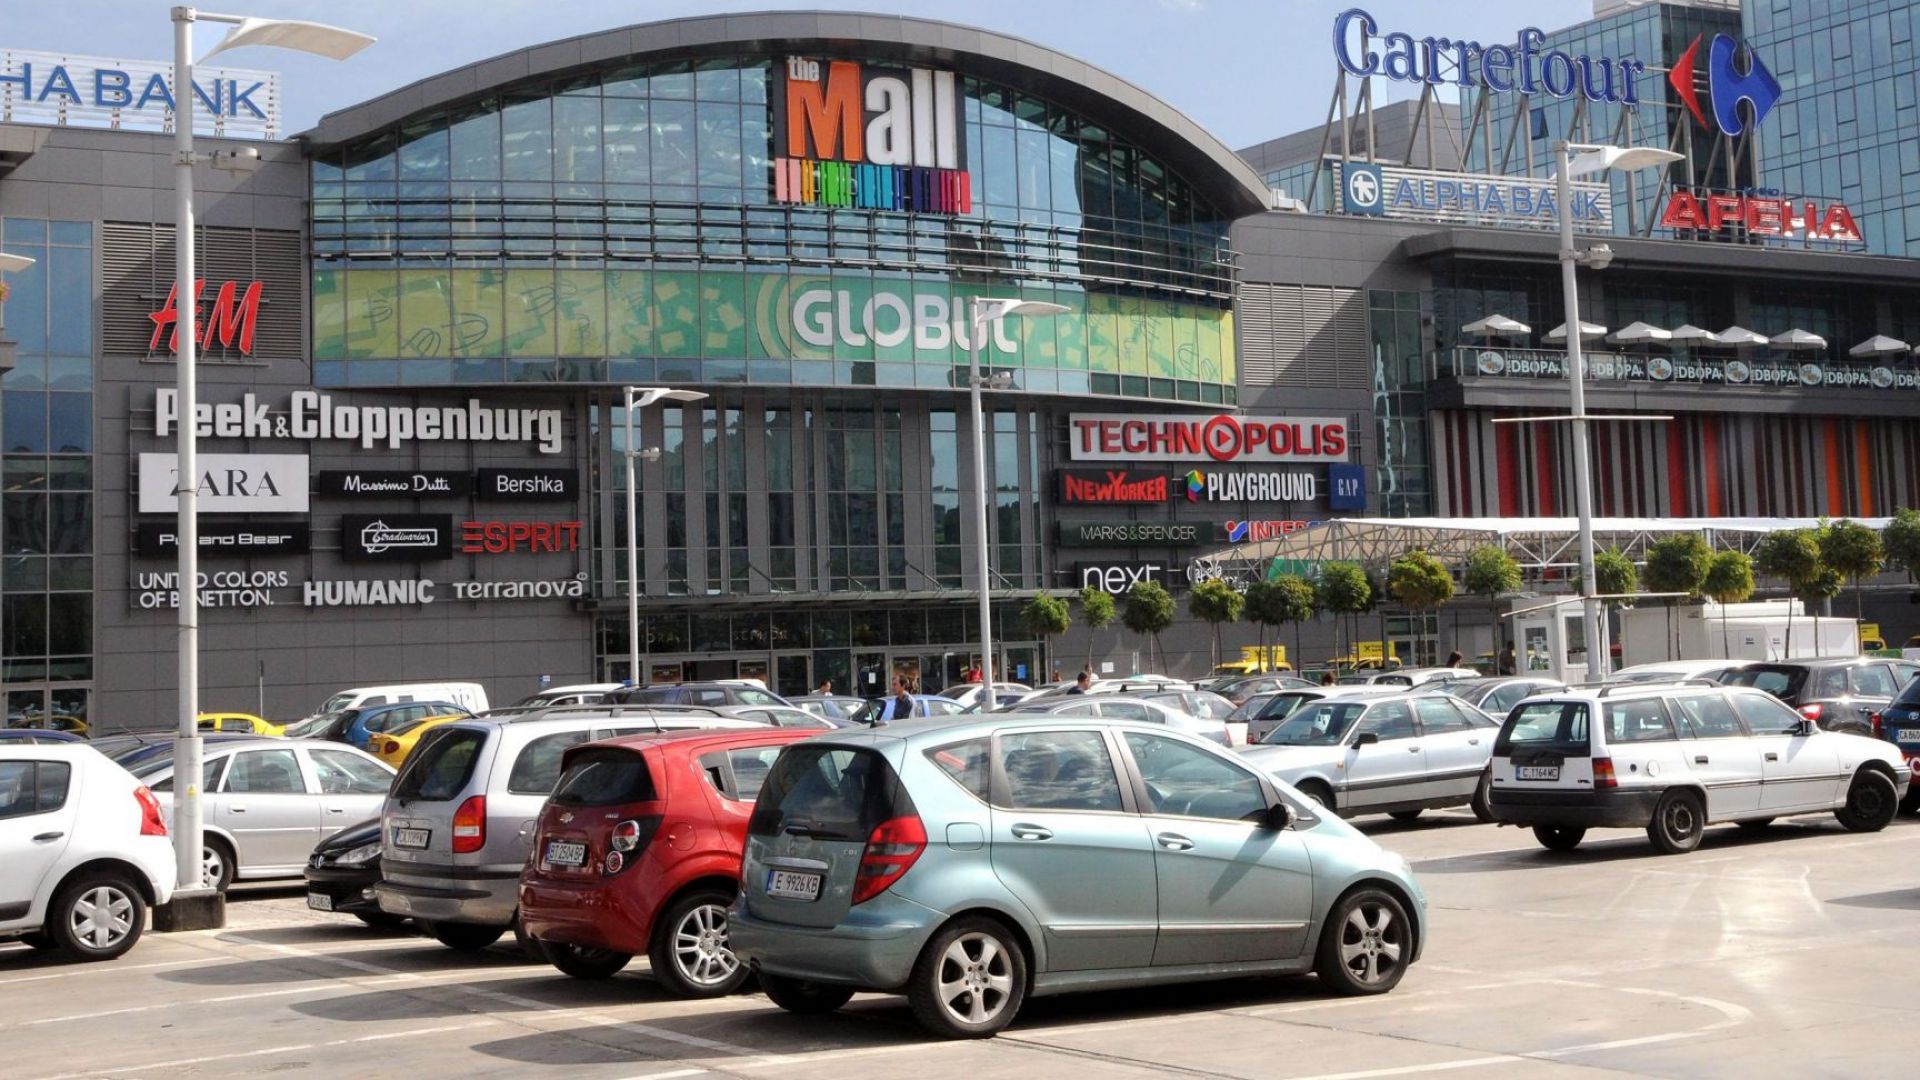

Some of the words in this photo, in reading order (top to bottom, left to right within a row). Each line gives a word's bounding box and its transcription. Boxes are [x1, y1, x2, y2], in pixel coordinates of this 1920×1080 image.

[787, 55, 820, 82] the
[1333, 8, 1644, 105] Carrefour
[94, 68, 268, 121] BANK
[787, 60, 958, 169] Mall
[1392, 177, 1505, 213] ALPHA
[792, 289, 1018, 353] GLOBUL
[1074, 414, 1345, 461] TECHNOPOLIS
[343, 475, 409, 492] Massimo
[412, 474, 451, 492] Dutti
[496, 474, 564, 493] Bershka
[1207, 472, 1316, 501] PLAYGROUND
[1337, 479, 1359, 497] GAP
[199, 535, 235, 545] and
[238, 533, 292, 545] Bear
[460, 521, 583, 553] ESPRIT
[139, 572, 208, 589] UNITD
[213, 570, 288, 588] COLORS
[303, 579, 435, 605] HUMANIC
[1083, 564, 1161, 594] next
[139, 591, 165, 609] OF
[170, 589, 275, 607] BNETTON.
